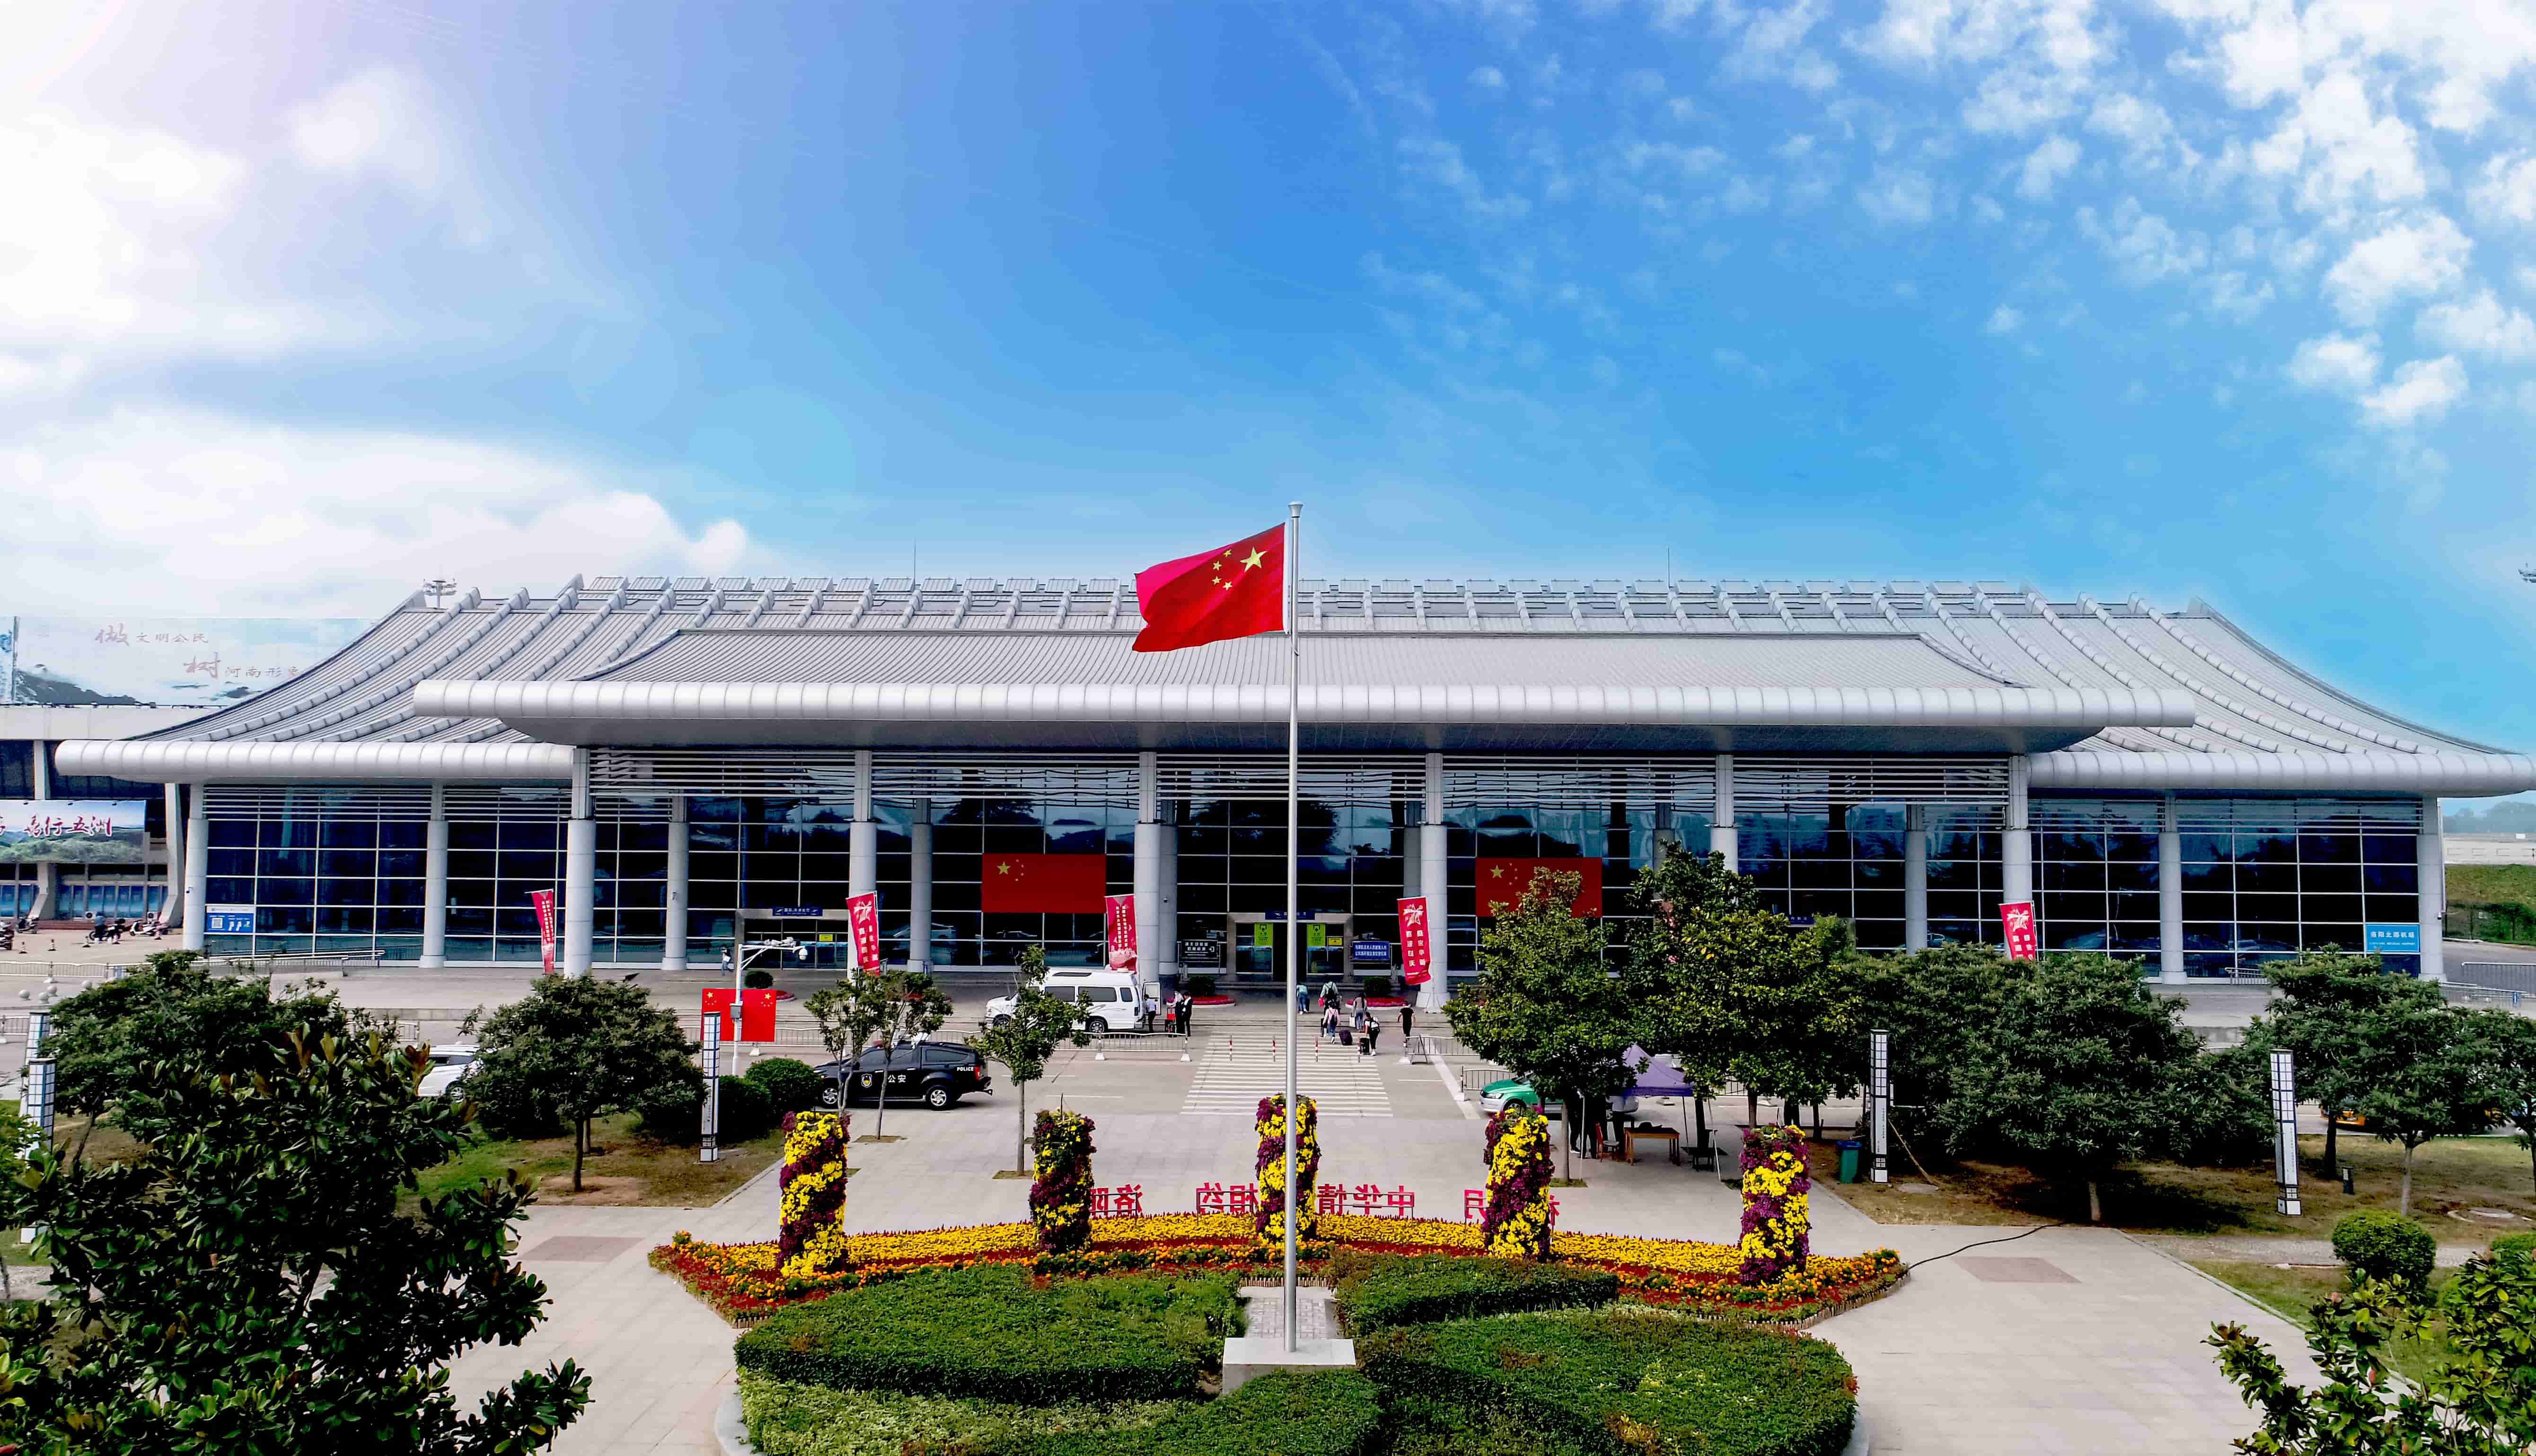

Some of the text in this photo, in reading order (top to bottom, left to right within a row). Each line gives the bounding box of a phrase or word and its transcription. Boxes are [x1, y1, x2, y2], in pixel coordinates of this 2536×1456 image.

[95, 623, 209, 646] 做文明公民
[888, 1074, 906, 1083] 公安
